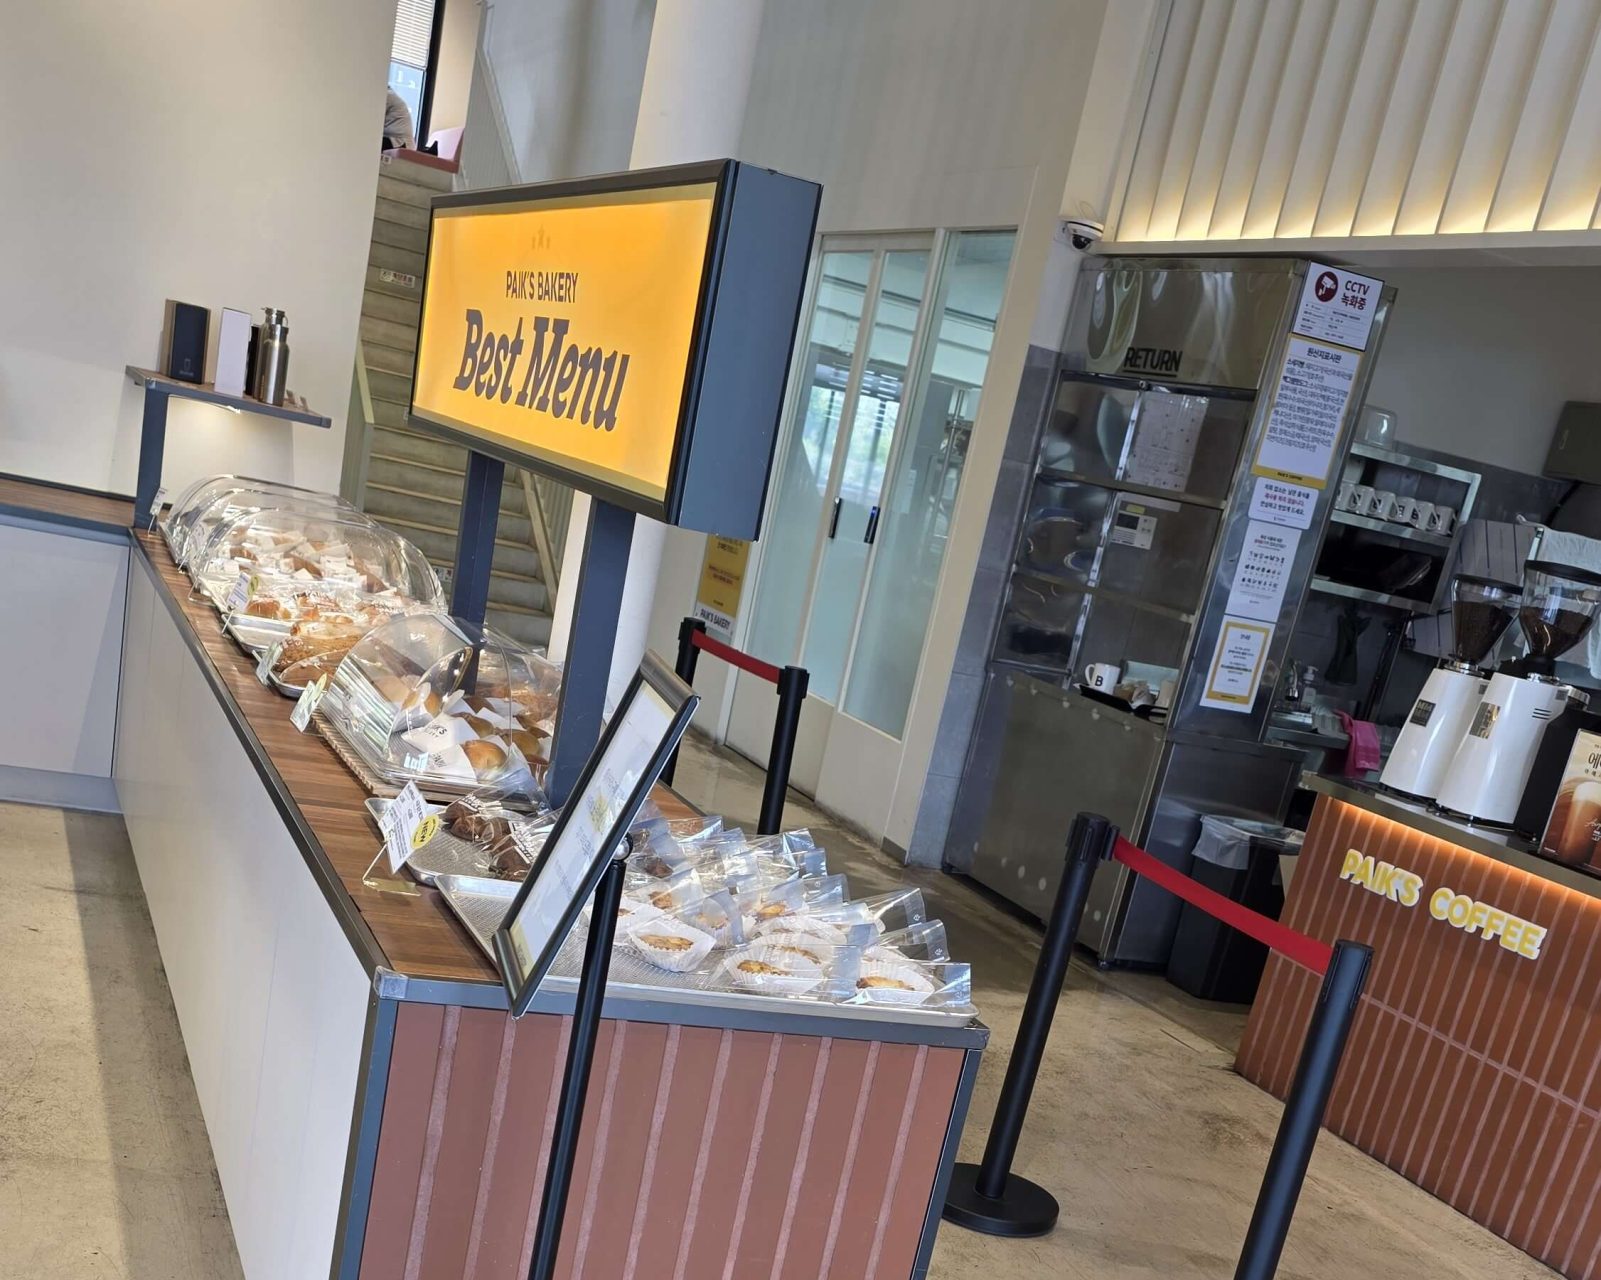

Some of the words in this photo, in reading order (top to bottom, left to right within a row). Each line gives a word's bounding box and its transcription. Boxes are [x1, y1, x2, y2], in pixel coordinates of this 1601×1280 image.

[506, 271, 535, 300] PAIK'S
[537, 272, 579, 303] BAKERY
[1345, 280, 1370, 295] CCTV
[1341, 293, 1367, 311] 녹화중
[453, 309, 524, 405] Best
[515, 316, 630, 432] Menu
[1123, 346, 1183, 372] RETURN
[1095, 675, 1104, 688] B
[1339, 848, 1424, 908] PAIK'S
[1429, 887, 1548, 960] COFFEE
